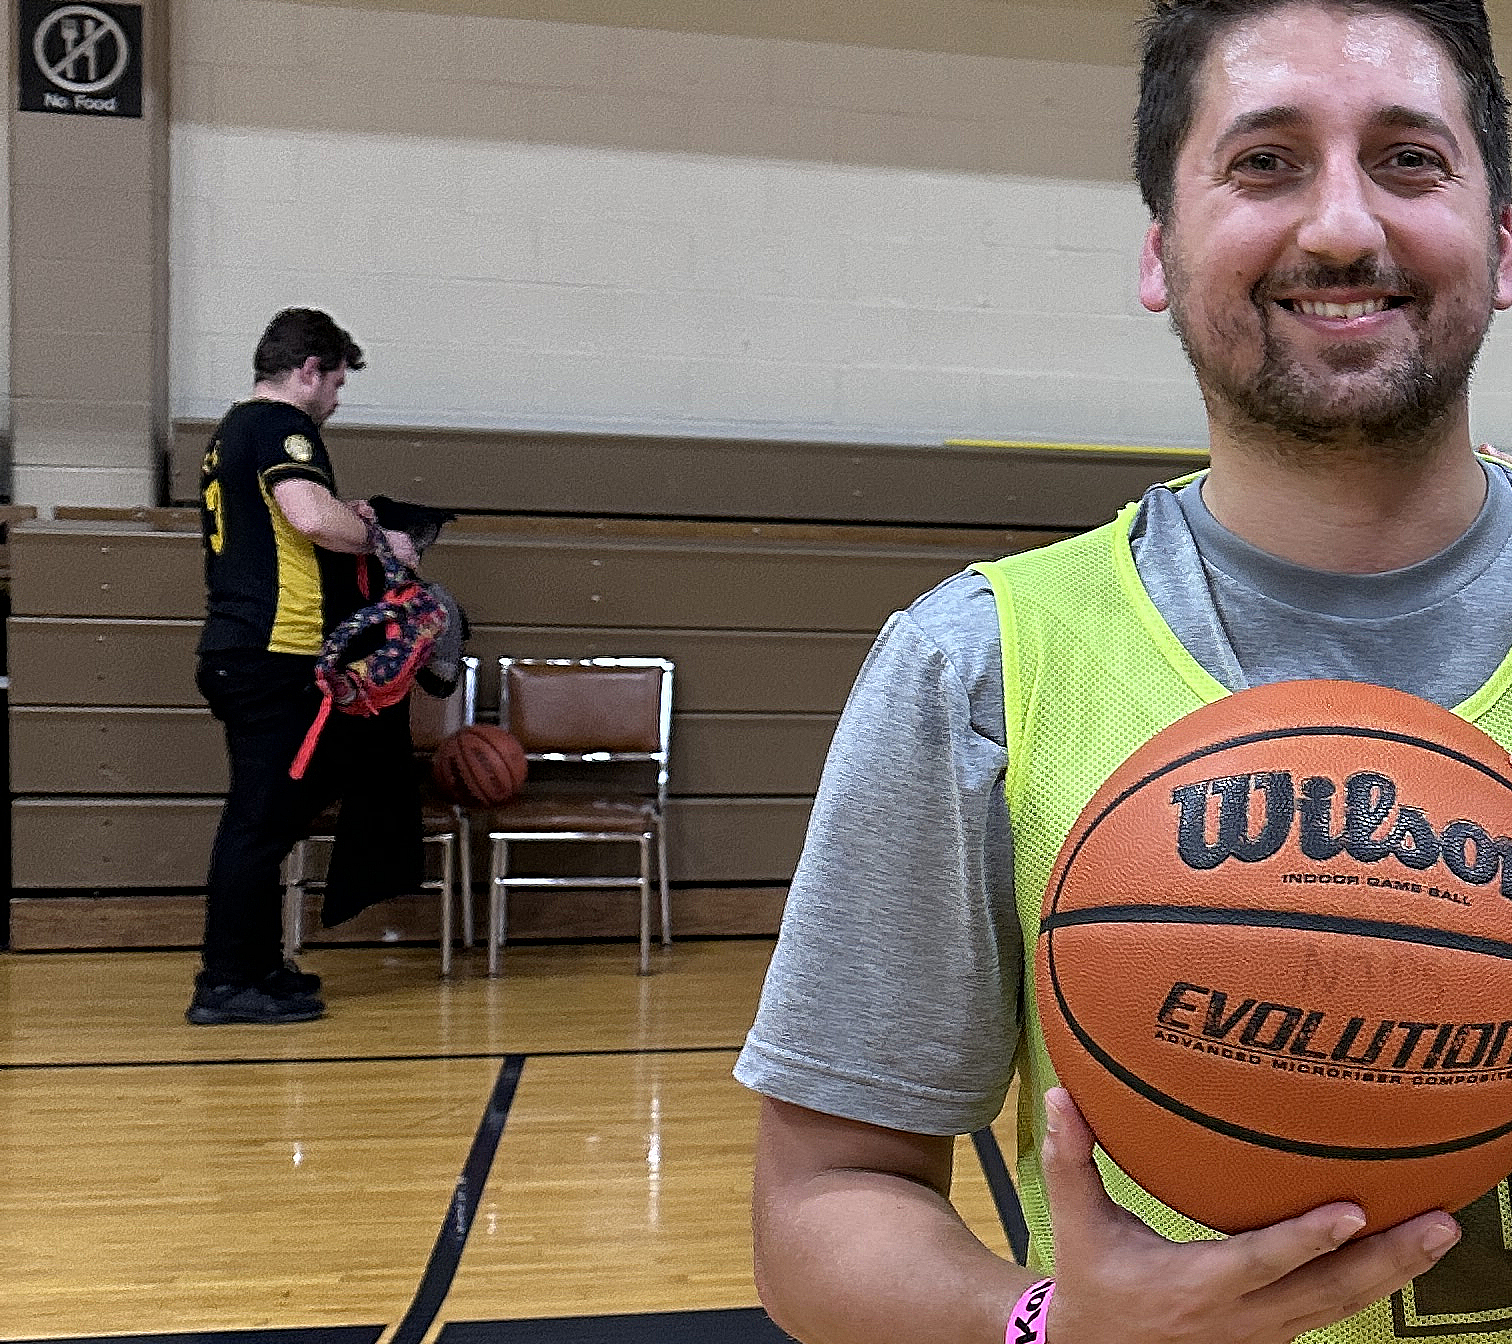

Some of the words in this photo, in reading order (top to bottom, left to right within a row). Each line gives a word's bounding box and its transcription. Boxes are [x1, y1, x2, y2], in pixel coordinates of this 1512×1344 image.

[43, 92, 73, 109] No
[74, 94, 118, 112] Food
[1282, 873, 1360, 886] INDOOR
[1366, 877, 1423, 894] GAME
[1428, 886, 1473, 907] BALL
[1154, 1030, 1262, 1065] ADVANCED
[1271, 1058, 1401, 1085] MICROFIBER
